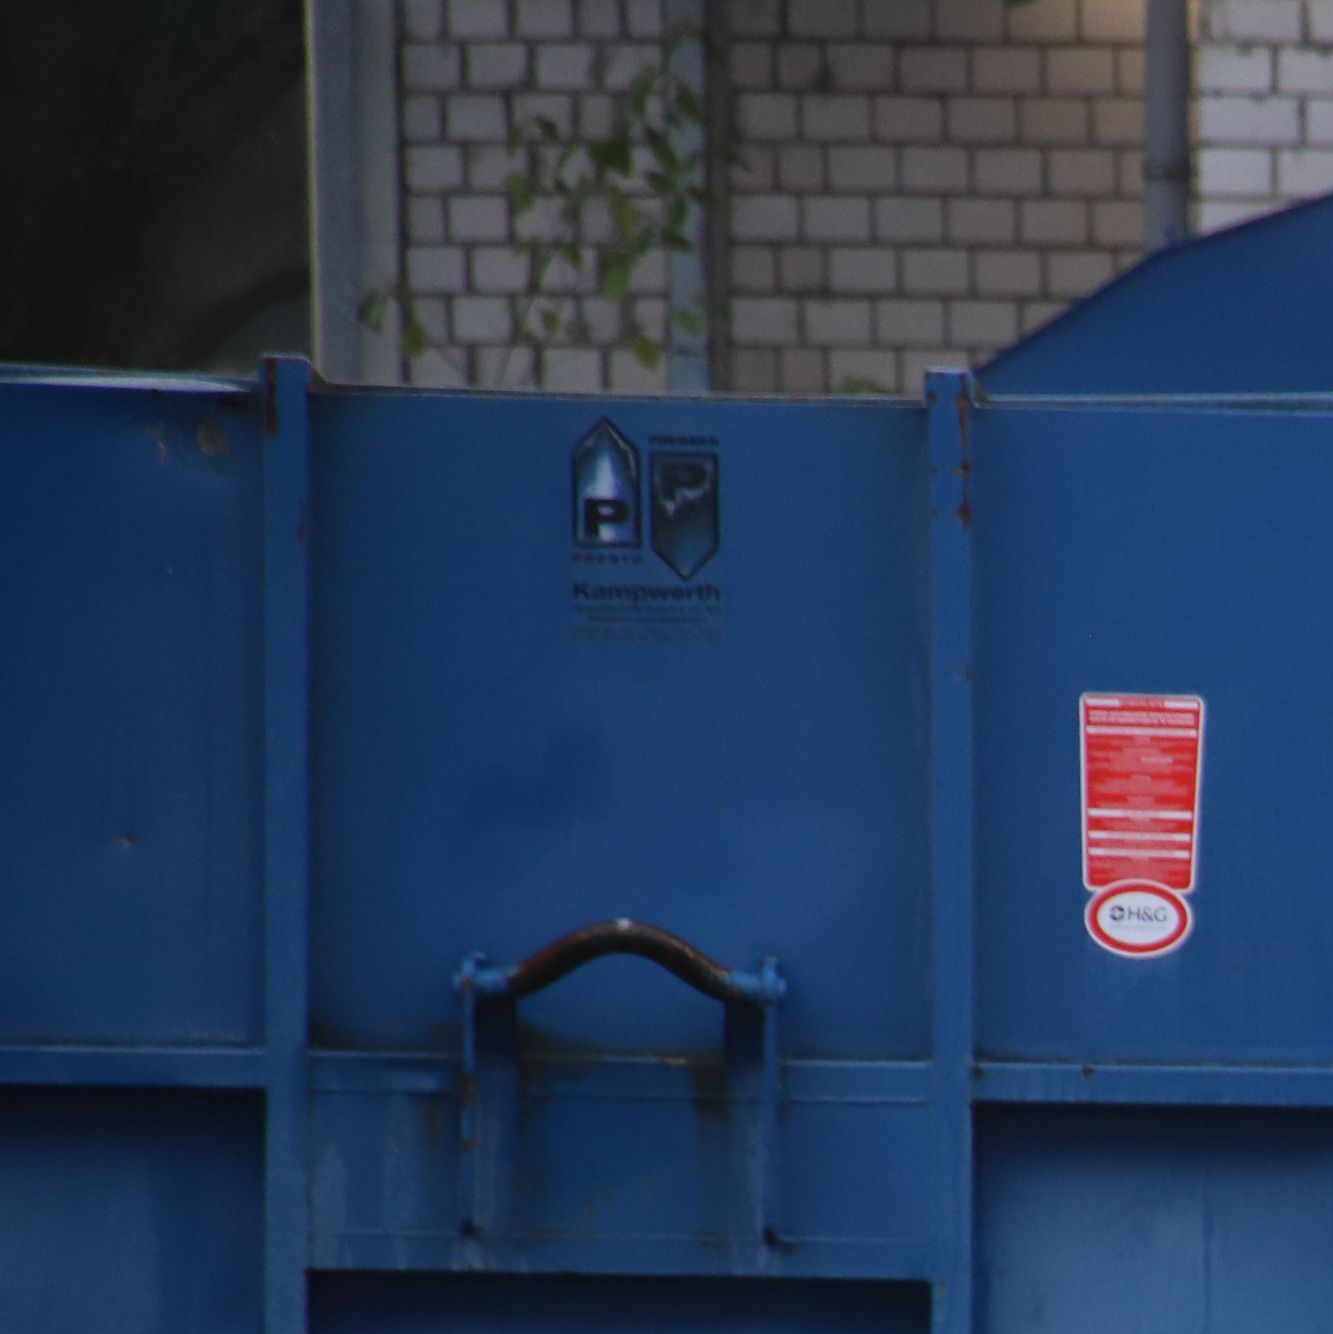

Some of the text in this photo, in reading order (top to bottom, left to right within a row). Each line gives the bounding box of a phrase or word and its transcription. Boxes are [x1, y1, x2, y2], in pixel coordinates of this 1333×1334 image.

[584, 499, 630, 537] P
[573, 583, 721, 603] Kampwerth
[1128, 905, 1168, 921] H&G
